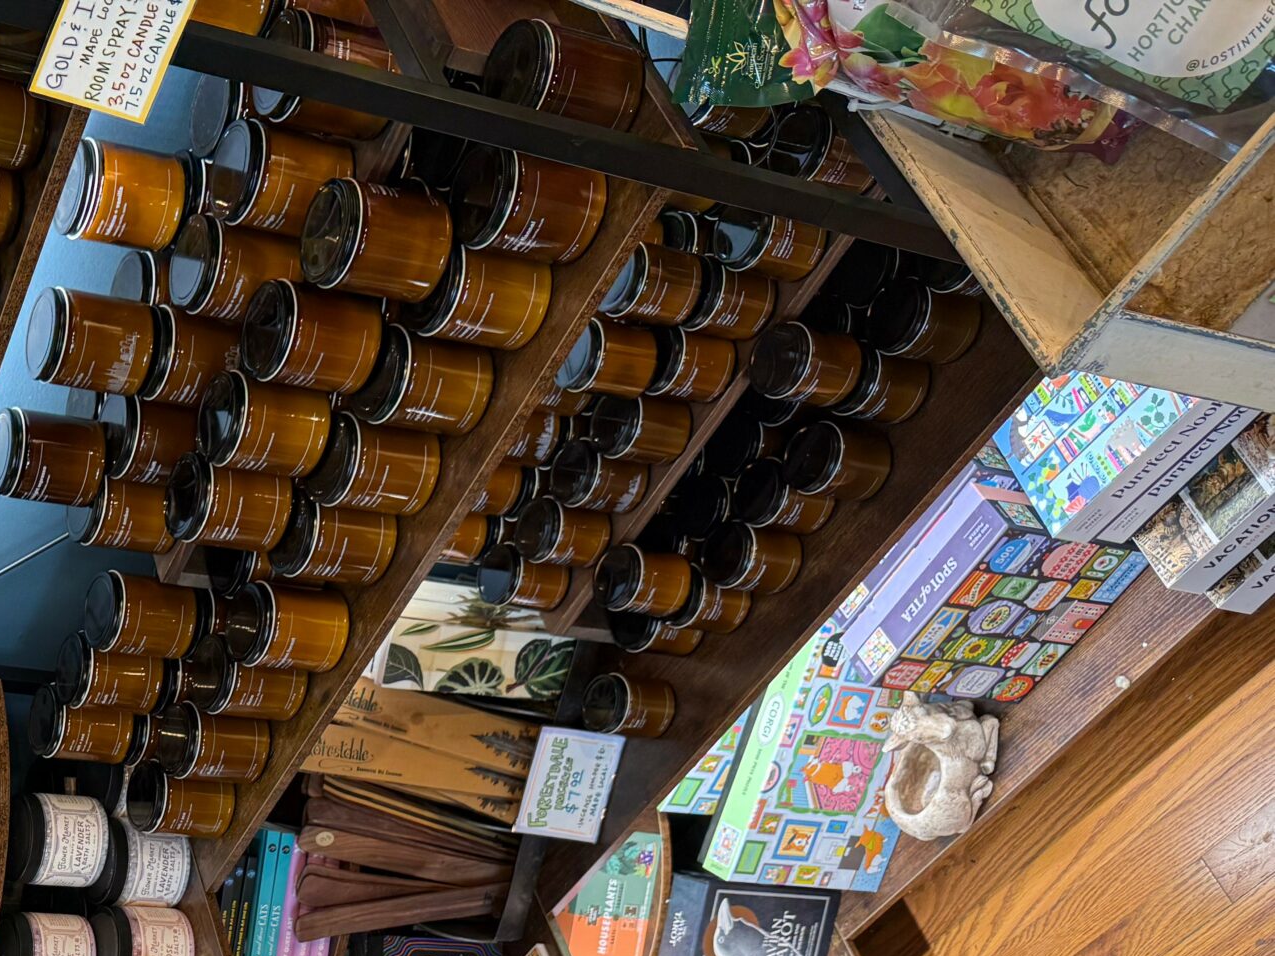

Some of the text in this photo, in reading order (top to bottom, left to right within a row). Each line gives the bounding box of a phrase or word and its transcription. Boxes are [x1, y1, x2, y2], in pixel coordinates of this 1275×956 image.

[84, 5, 138, 102] ROOM SPRAY
[107, 81, 126, 107] 3.5
[127, 3, 159, 58] CANDLE
[124, 85, 143, 111] 7.5
[143, 10, 176, 63] CANDLE
[748, 43, 757, 79] American
[1111, 437, 1182, 499] Purrfect
[1147, 436, 1219, 497] Purrfect
[994, 546, 1015, 565] 500
[900, 556, 958, 623] SPOT of TEA
[1039, 652, 1057, 669] TEA
[760, 700, 781, 739] CORGI
[74, 821, 84, 867] LAVENDER
[157, 848, 169, 893] LAVENDER
[283, 931, 292, 953] QUEER
[597, 878, 619, 955] HOUSEPLANTS
